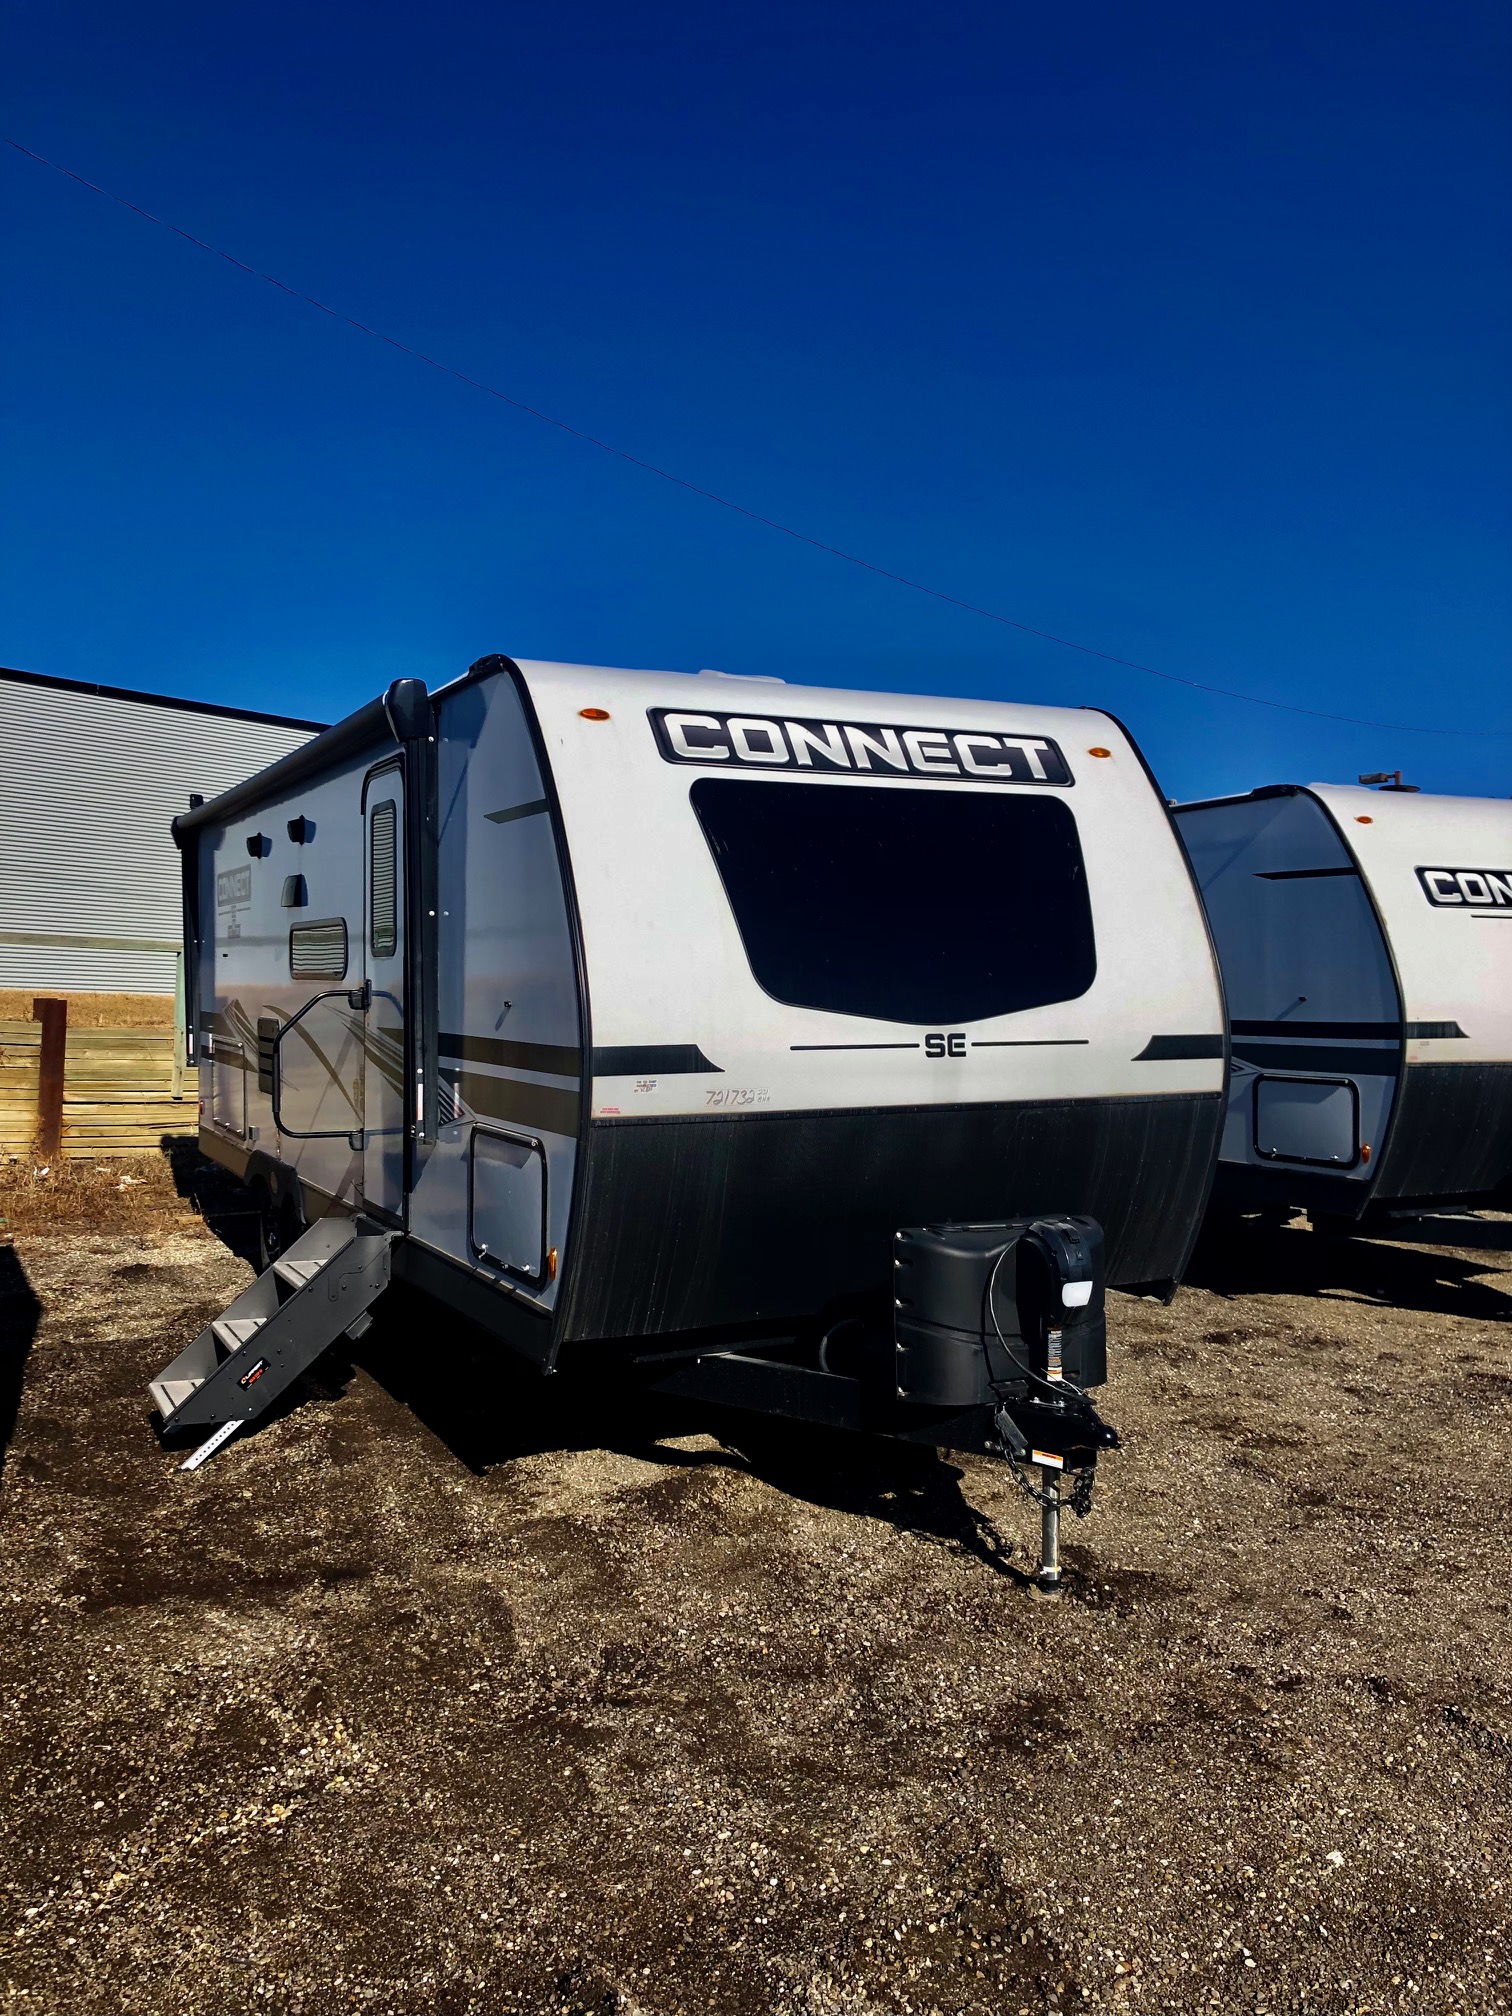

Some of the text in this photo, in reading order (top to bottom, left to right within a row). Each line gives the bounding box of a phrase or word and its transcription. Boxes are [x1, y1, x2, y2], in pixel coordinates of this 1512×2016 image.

[664, 712, 1052, 780] CONNECT
[924, 1032, 967, 1058] SE
[705, 1089, 756, 1106] 721732
